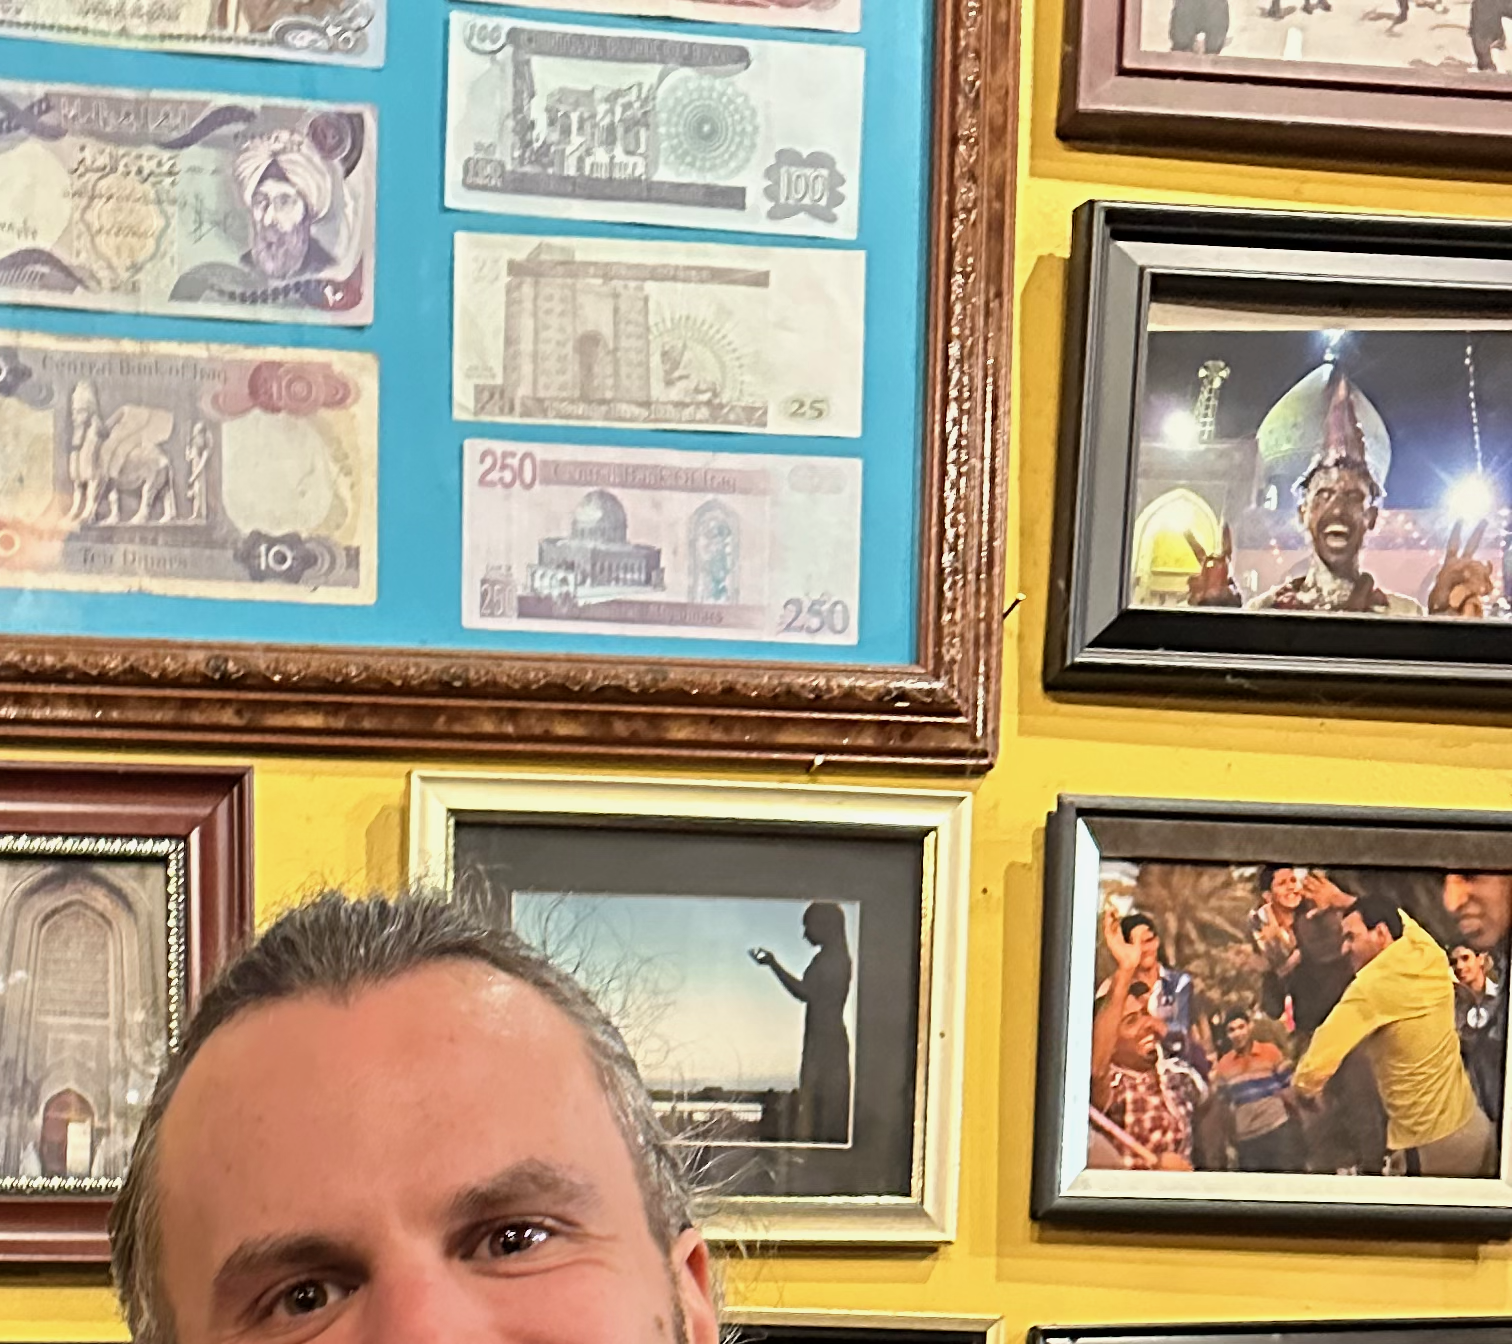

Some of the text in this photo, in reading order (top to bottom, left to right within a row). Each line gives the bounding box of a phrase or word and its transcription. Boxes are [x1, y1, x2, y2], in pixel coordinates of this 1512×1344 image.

[779, 168, 830, 205] 100
[119, 359, 160, 378] Bank
[789, 399, 827, 420] 25
[477, 450, 538, 491] 250
[257, 542, 294, 571] 10
[779, 597, 850, 635] 250
